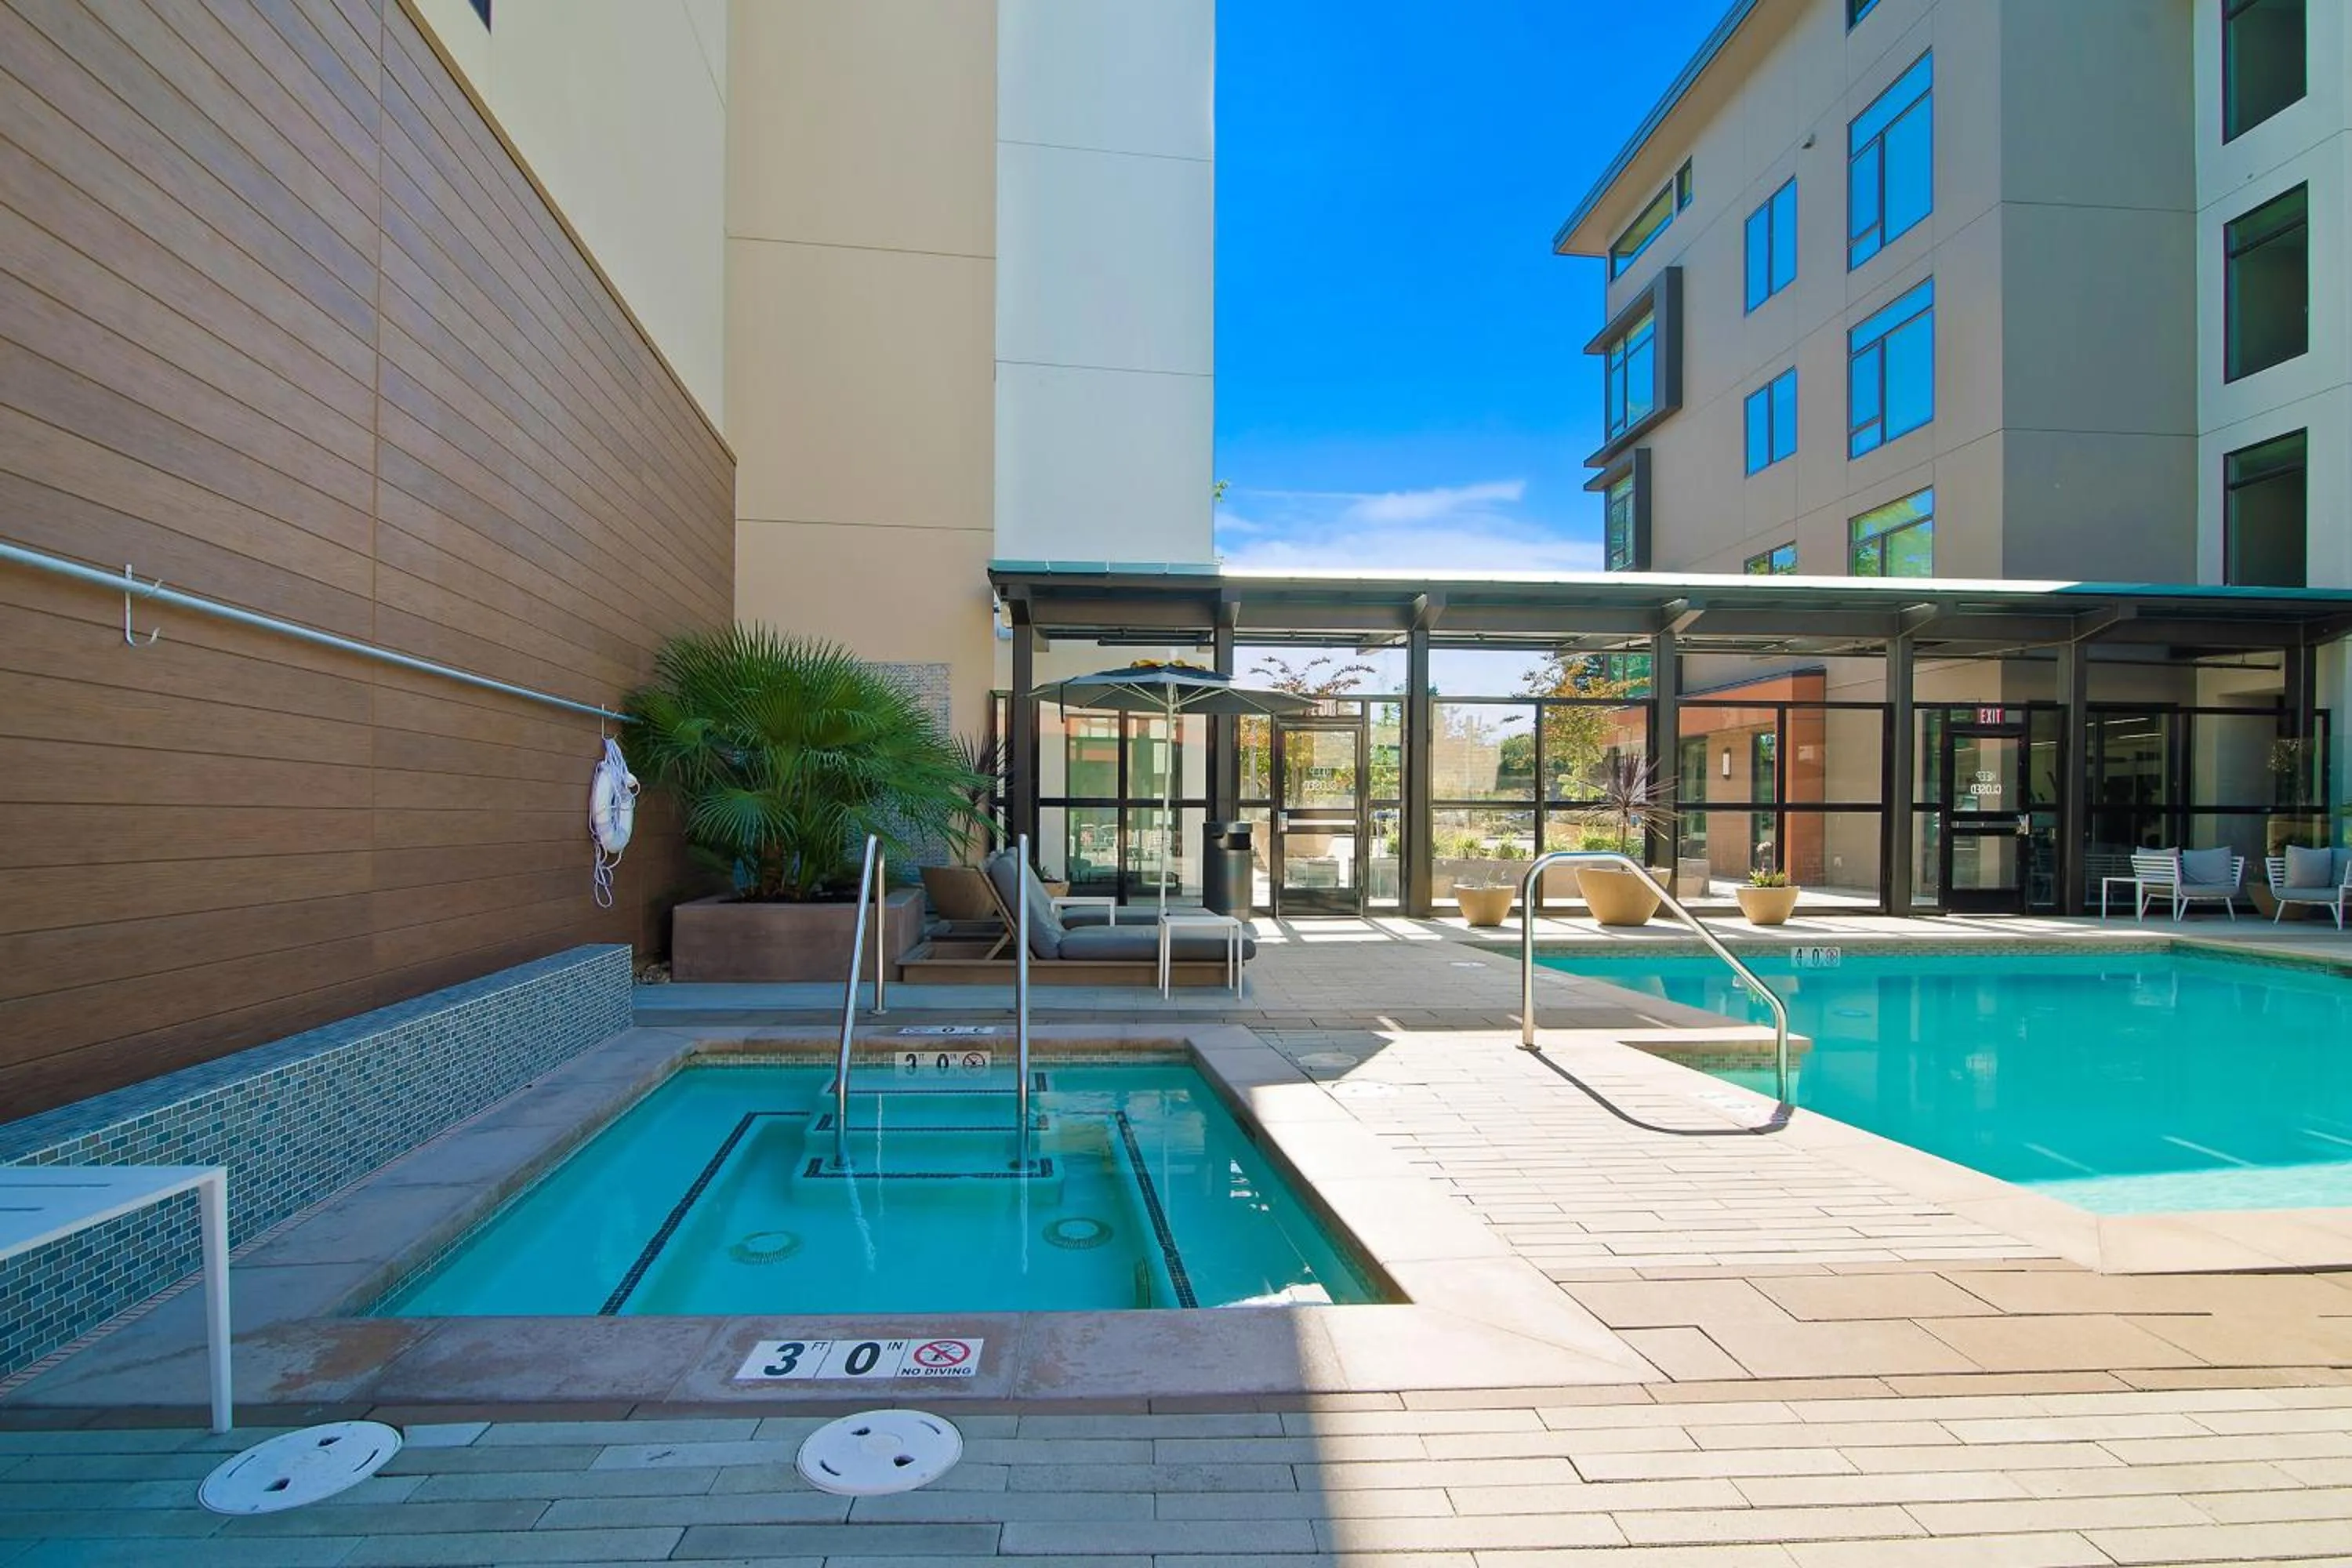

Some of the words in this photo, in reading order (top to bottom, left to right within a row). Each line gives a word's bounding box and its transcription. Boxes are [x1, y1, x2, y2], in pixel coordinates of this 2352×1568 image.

[1980, 708, 2003, 724] EXIT
[763, 1341, 805, 1376] 3
[811, 1342, 828, 1351] FT
[844, 1341, 881, 1376] 0
[887, 1341, 903, 1351] IN
[902, 1367, 922, 1376] NO
[924, 1367, 972, 1376] DIVING
